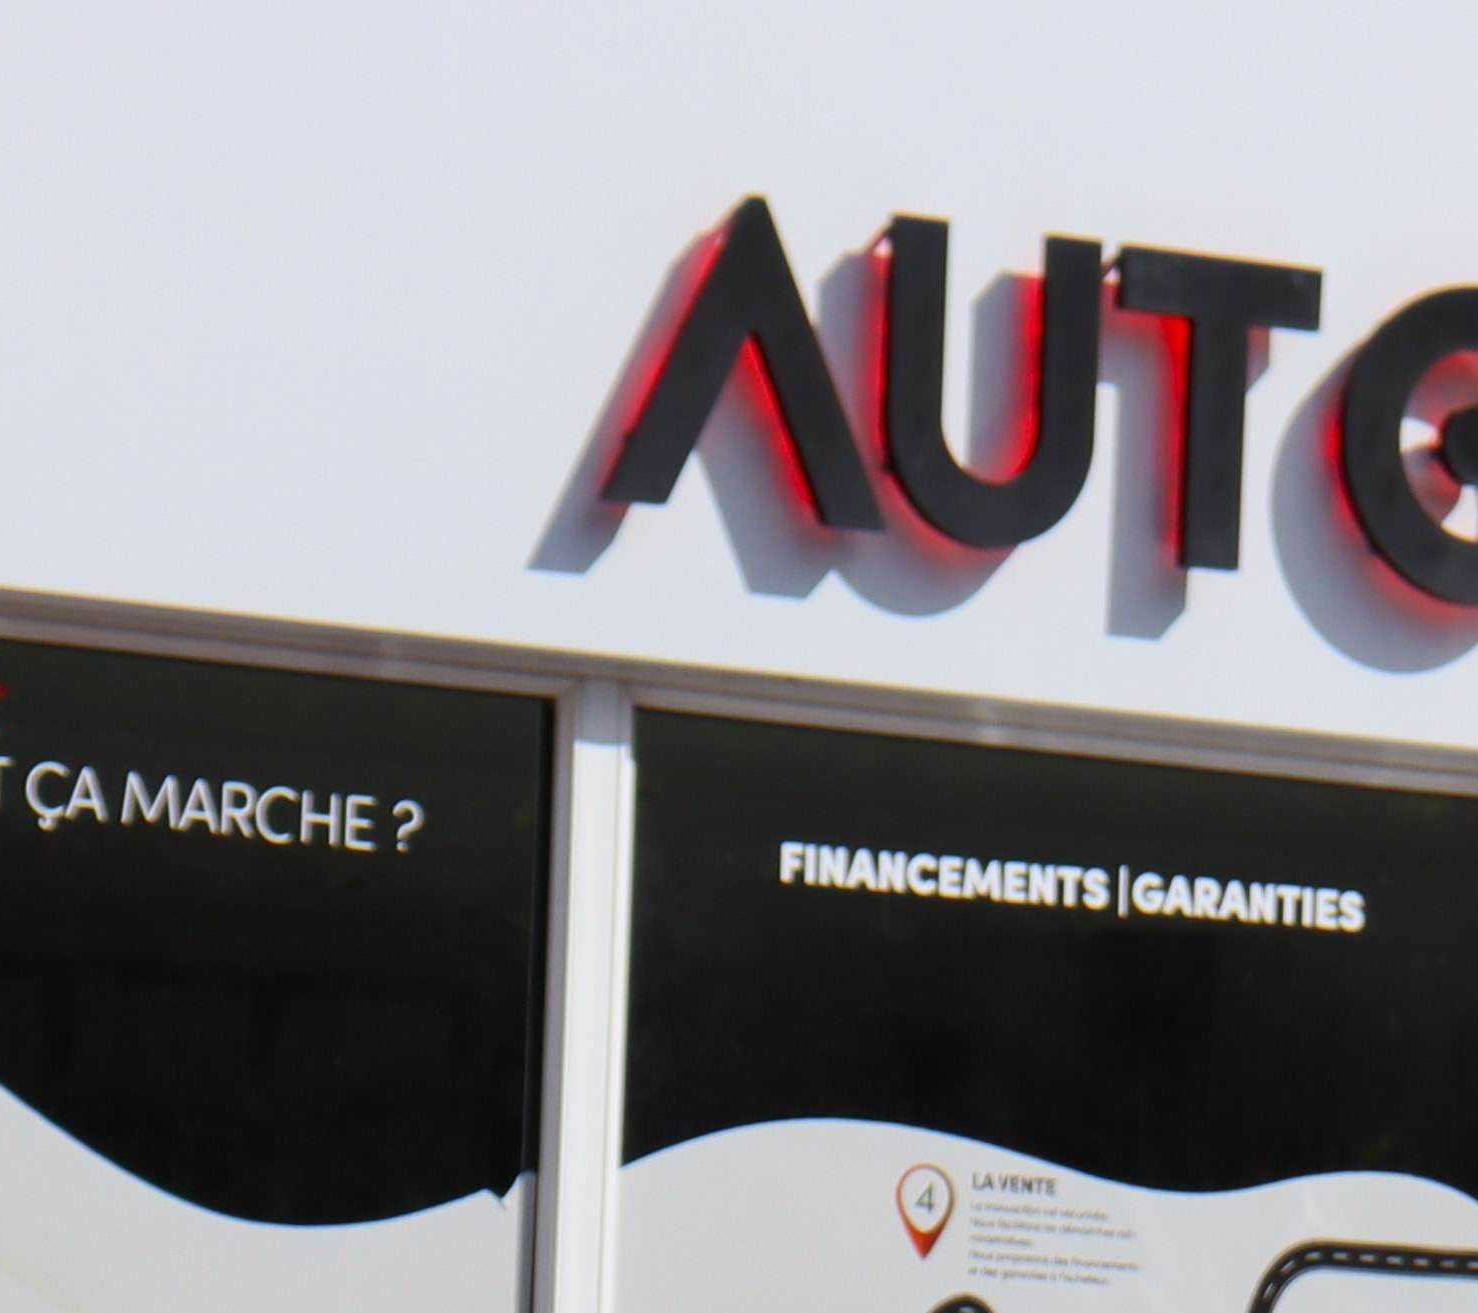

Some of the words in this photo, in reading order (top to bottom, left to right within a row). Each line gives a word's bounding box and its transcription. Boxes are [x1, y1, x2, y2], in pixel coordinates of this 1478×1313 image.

[25, 759, 109, 831] ÇA
[121, 770, 377, 852] MARCHE
[780, 841, 1108, 910] FINANCEMENTS
[1132, 872, 1366, 932] GARANTIES
[915, 1183, 935, 1214] 4
[972, 1171, 994, 1190] LA
[998, 1174, 1057, 1196] VENTE
